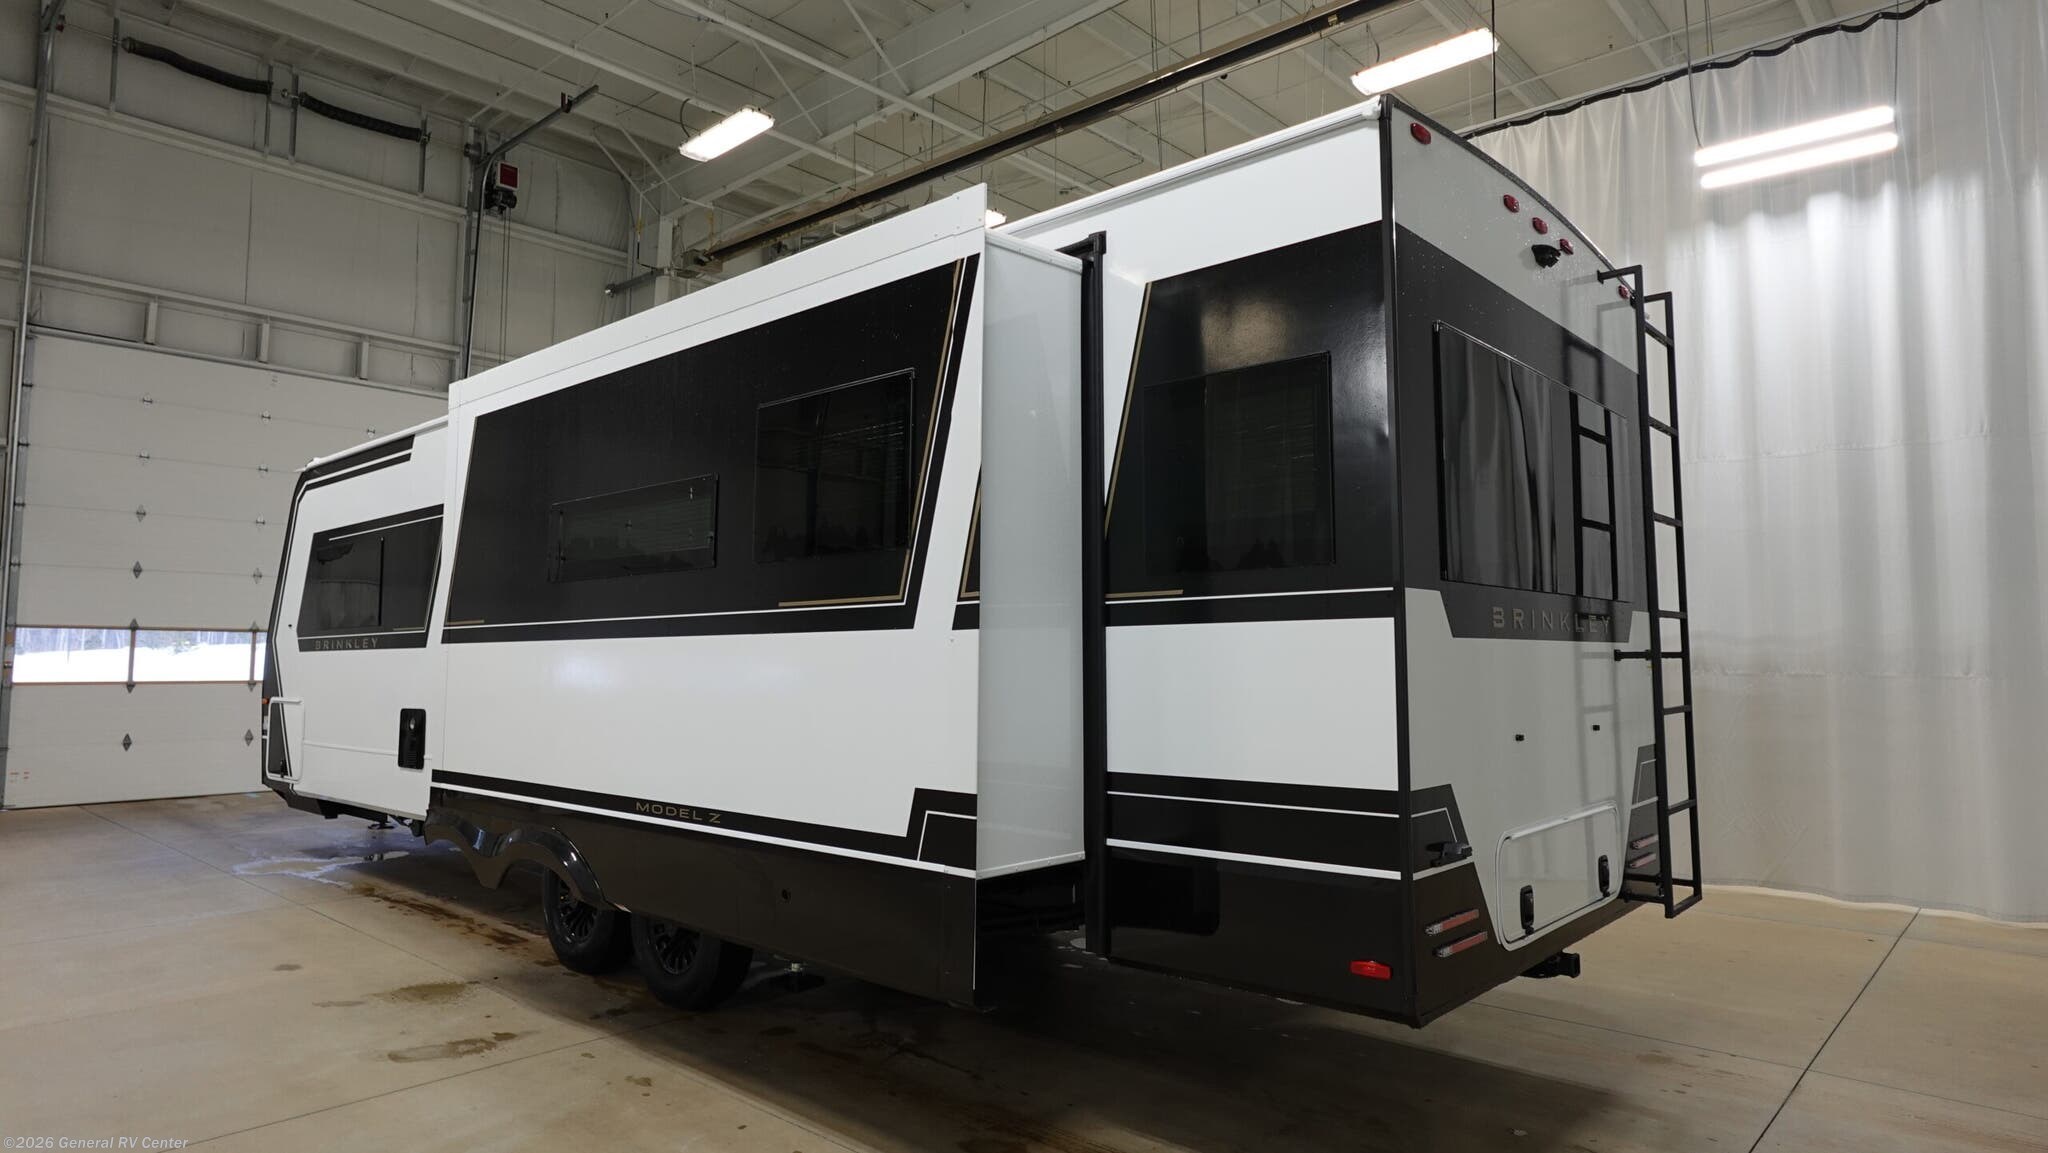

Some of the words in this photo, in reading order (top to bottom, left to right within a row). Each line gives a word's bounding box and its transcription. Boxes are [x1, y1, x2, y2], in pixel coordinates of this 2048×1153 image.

[1493, 607, 1610, 633] BRINKLEY
[315, 638, 378, 650] BRINKLEY
[636, 802, 702, 820] MODEL
[708, 813, 721, 823] Z
